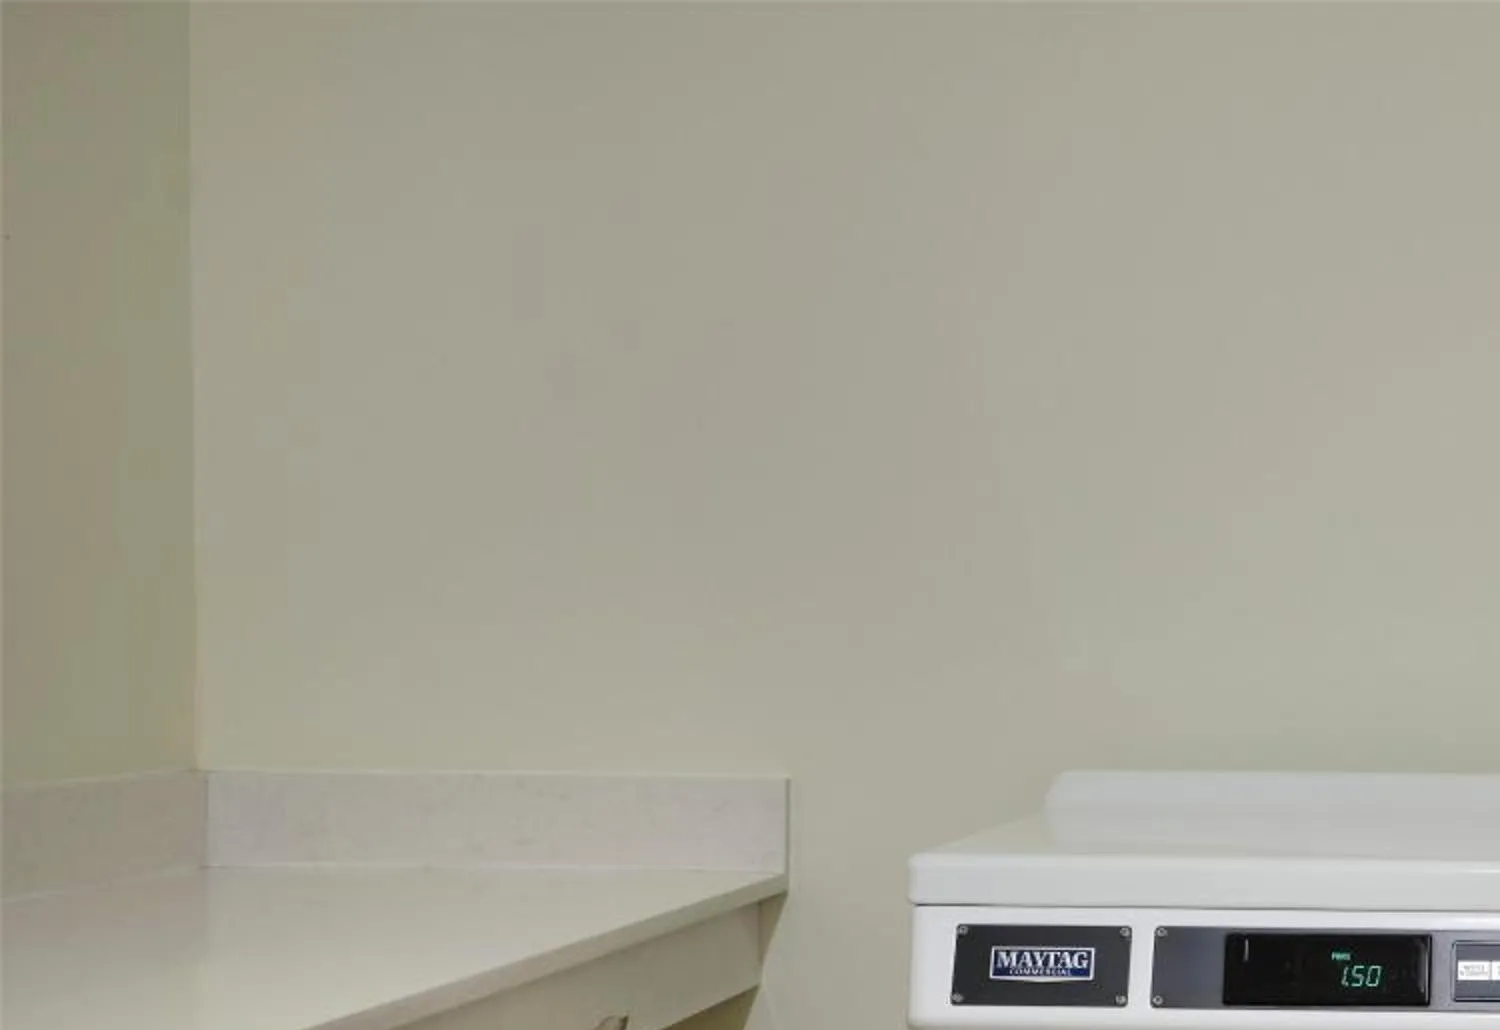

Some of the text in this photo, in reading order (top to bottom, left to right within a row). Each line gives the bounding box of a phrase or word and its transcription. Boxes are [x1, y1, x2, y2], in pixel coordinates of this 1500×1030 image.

[996, 951, 1089, 969] MAYTAG
[1009, 967, 1072, 976] COMMERCIAL
[1341, 965, 1382, 987] 1.50
